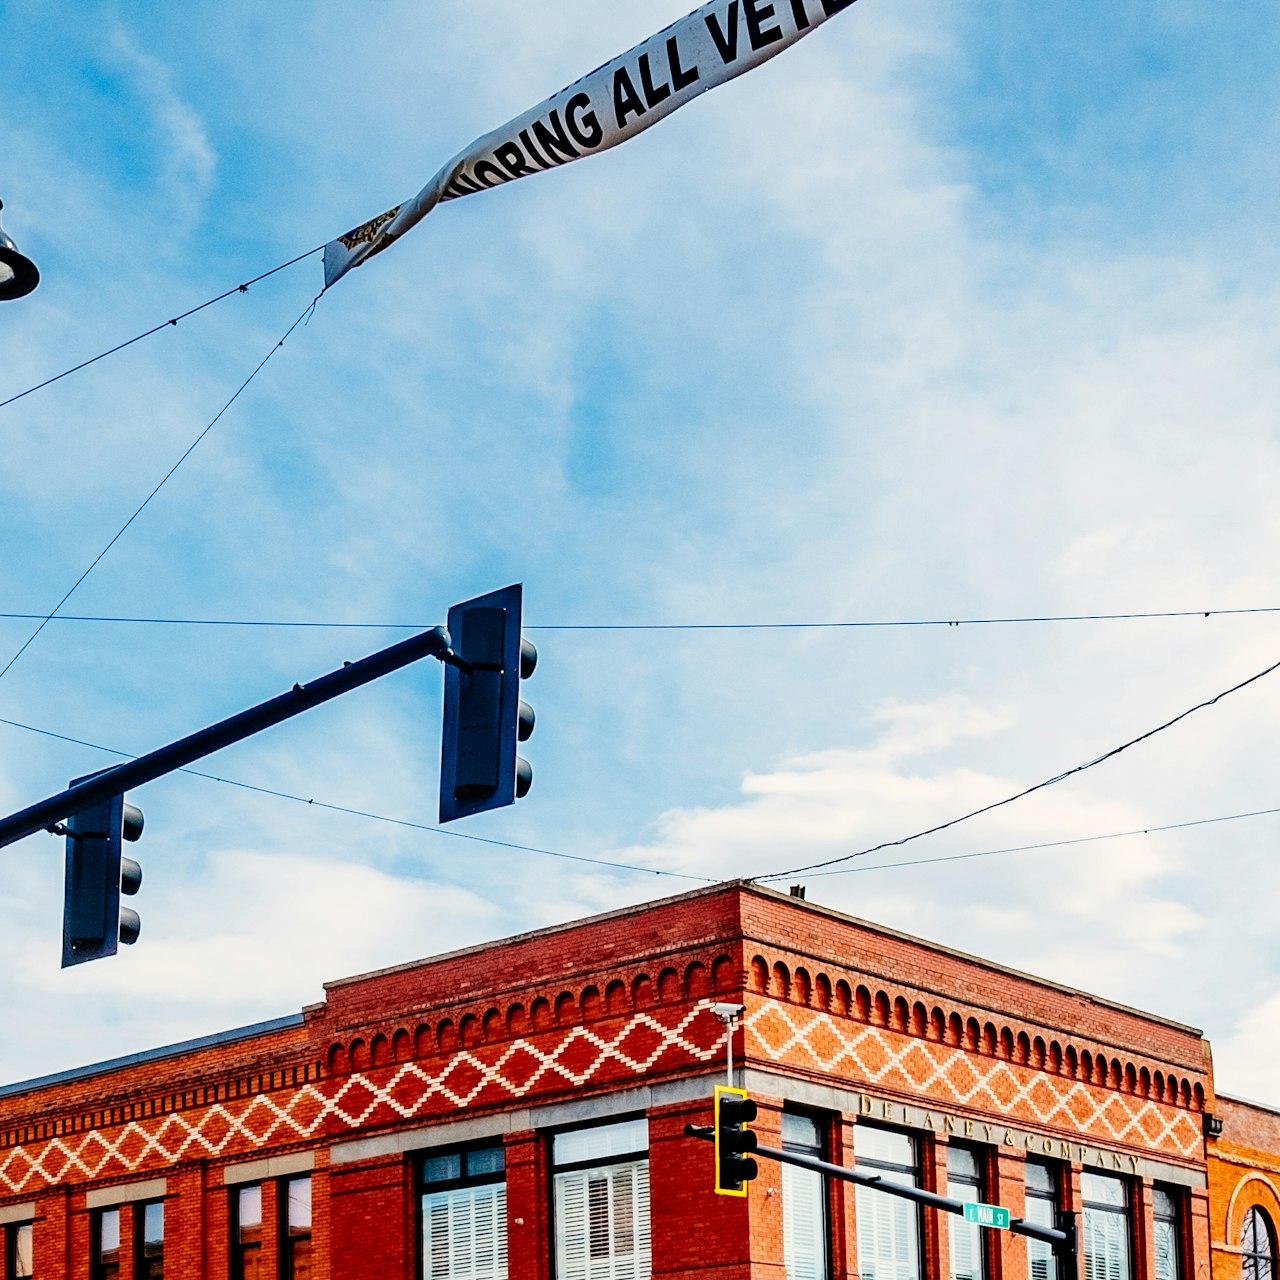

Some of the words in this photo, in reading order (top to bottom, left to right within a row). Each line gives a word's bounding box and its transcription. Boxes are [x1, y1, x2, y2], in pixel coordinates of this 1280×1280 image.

[615, 36, 700, 130] ALL
[859, 1093, 993, 1142] DELANEY
[1004, 1128, 1016, 1146] &
[1025, 1133, 1141, 1175] COMPANY
